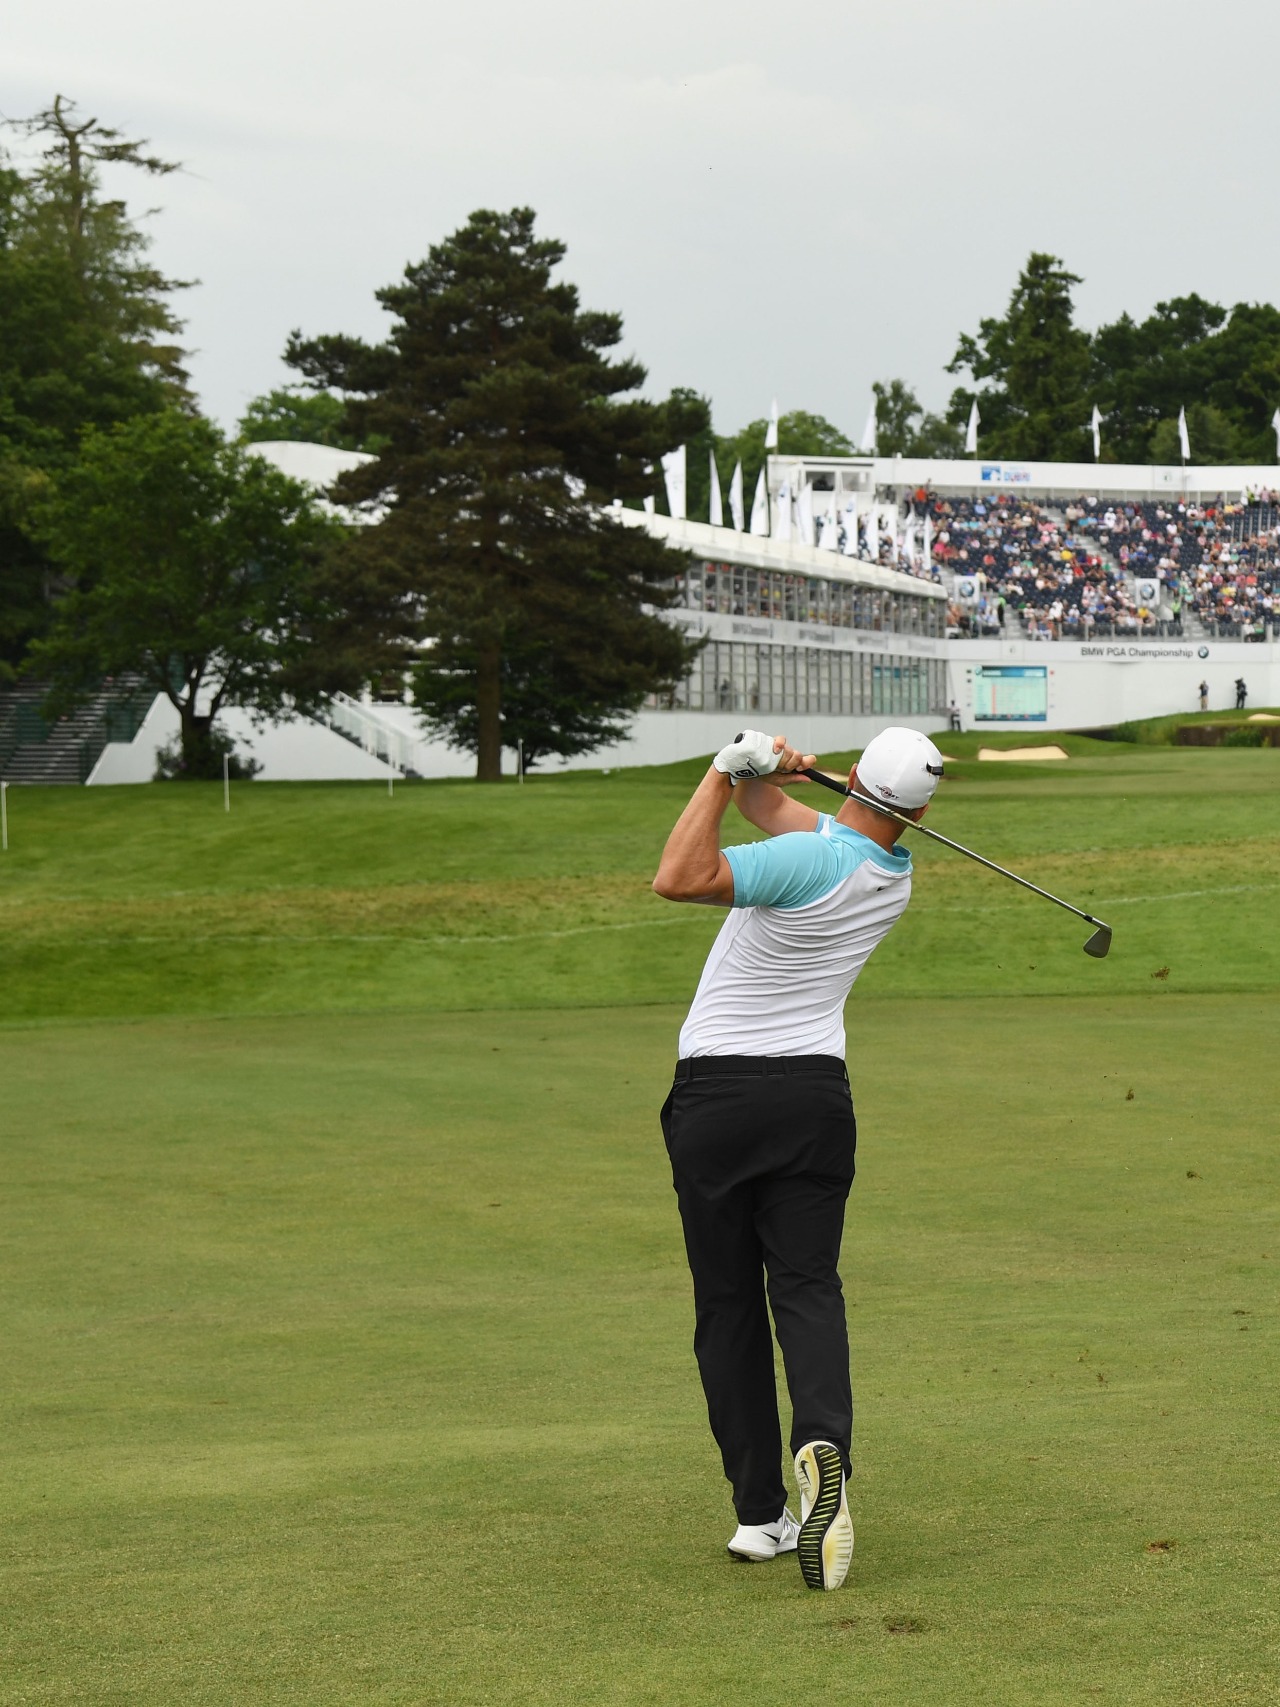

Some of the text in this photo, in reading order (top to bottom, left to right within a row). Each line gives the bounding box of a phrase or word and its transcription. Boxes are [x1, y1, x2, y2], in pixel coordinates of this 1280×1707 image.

[1081, 647, 1193, 658] BMW PGA Championship
